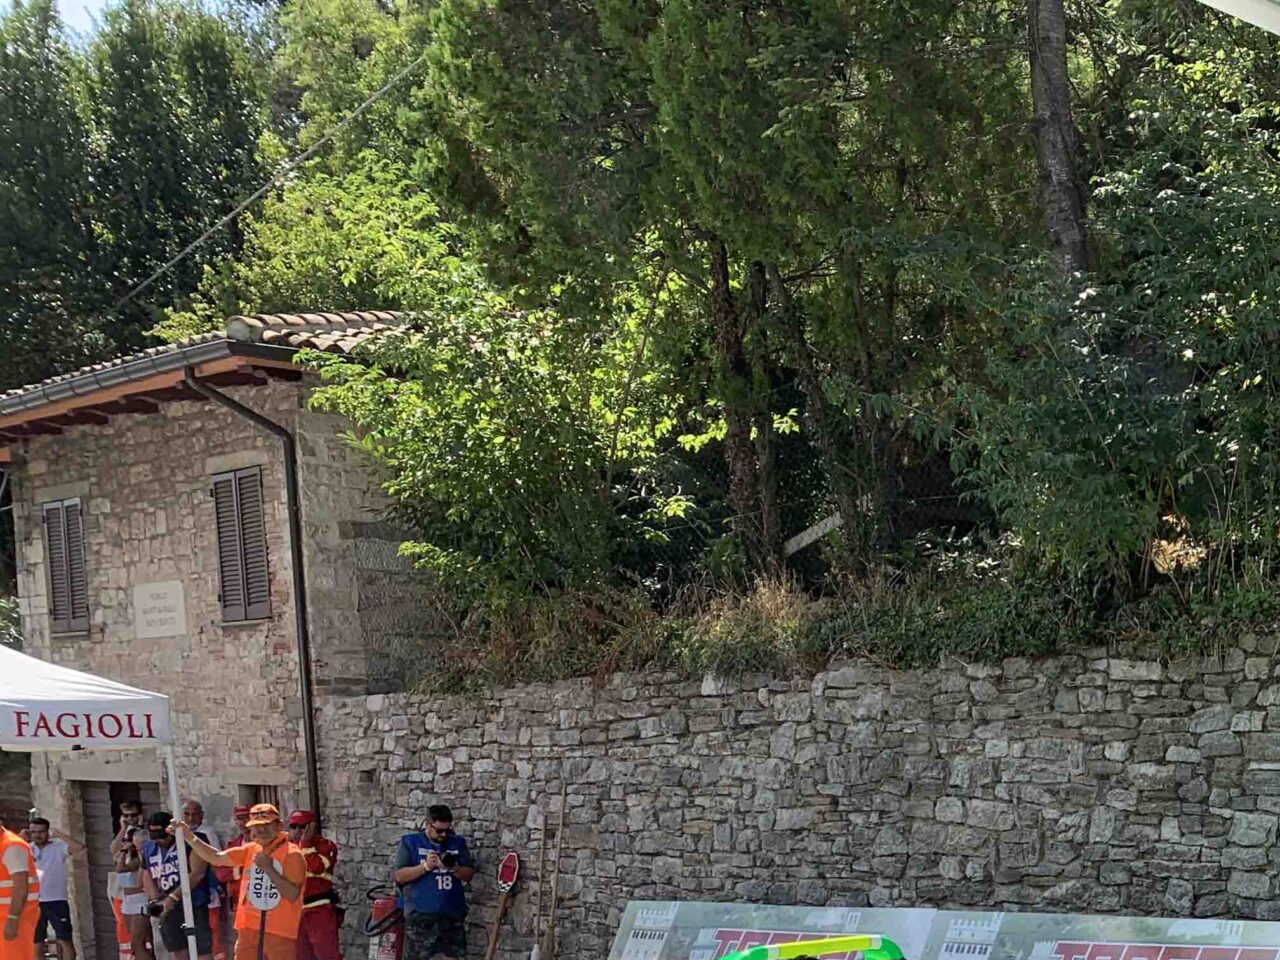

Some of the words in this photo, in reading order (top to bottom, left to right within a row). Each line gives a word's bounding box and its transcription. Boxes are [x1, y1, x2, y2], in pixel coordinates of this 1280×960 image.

[13, 711, 157, 738] FAGIOLI
[253, 866, 264, 899] STOP
[435, 876, 452, 890] 18
